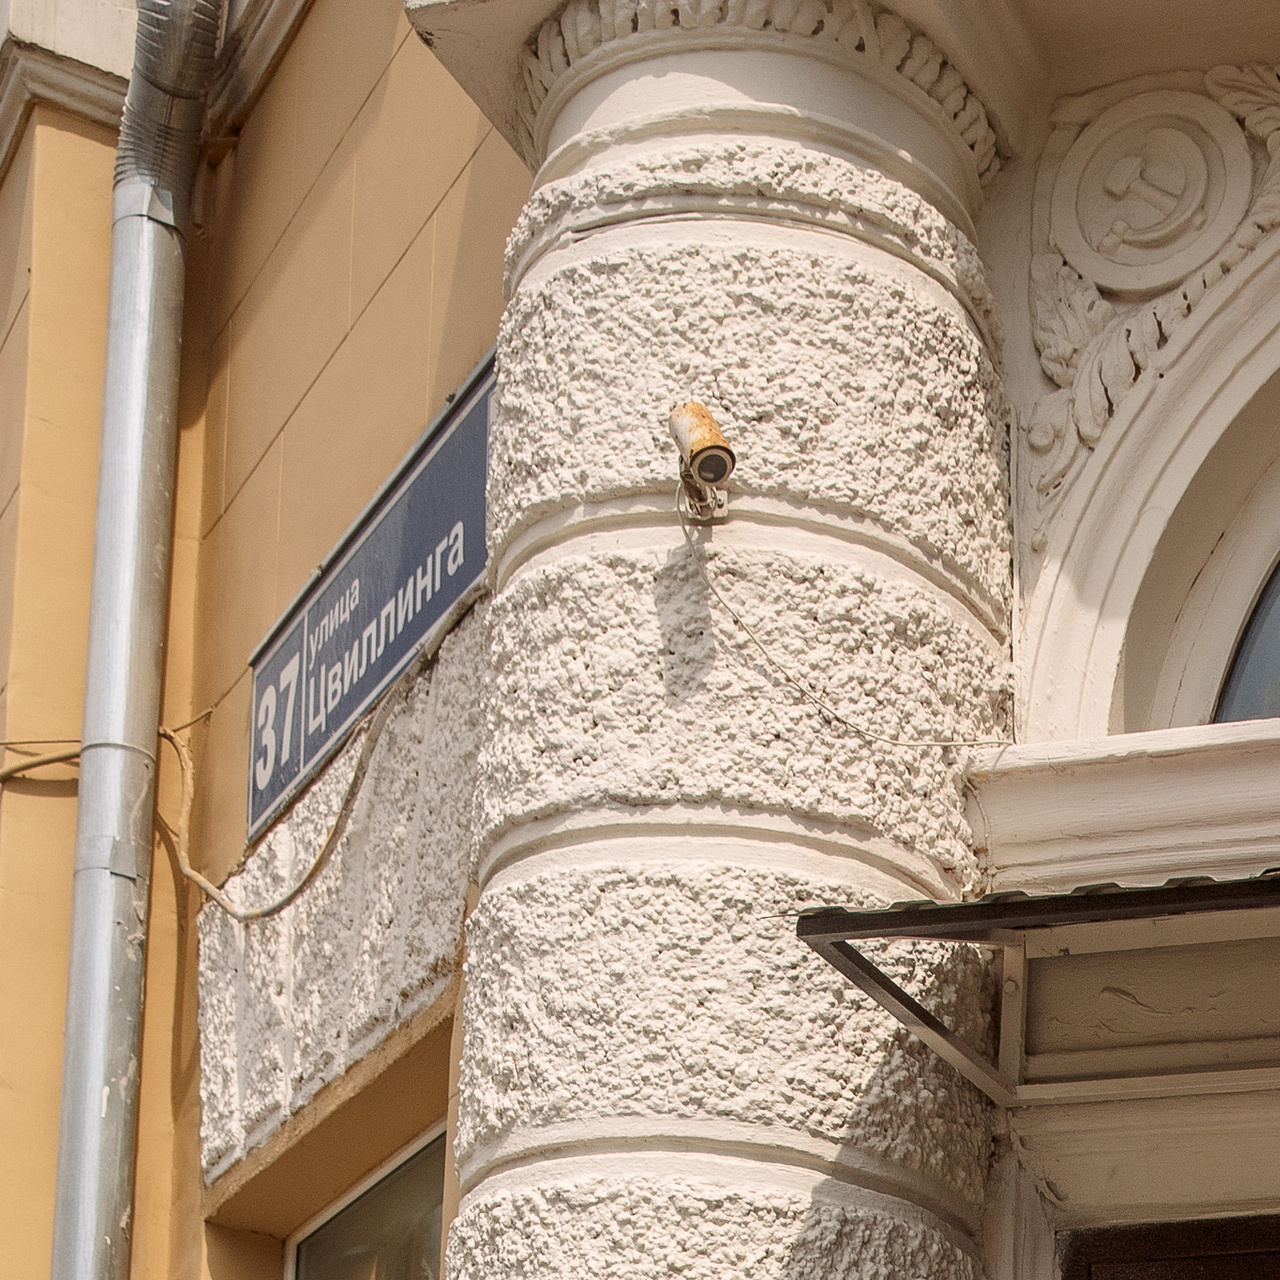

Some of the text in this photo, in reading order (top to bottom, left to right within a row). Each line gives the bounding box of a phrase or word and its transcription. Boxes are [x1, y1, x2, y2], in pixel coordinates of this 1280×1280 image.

[308, 520, 464, 736] Цвиллинга
[309, 578, 360, 671] улица
[255, 652, 300, 790] 37
